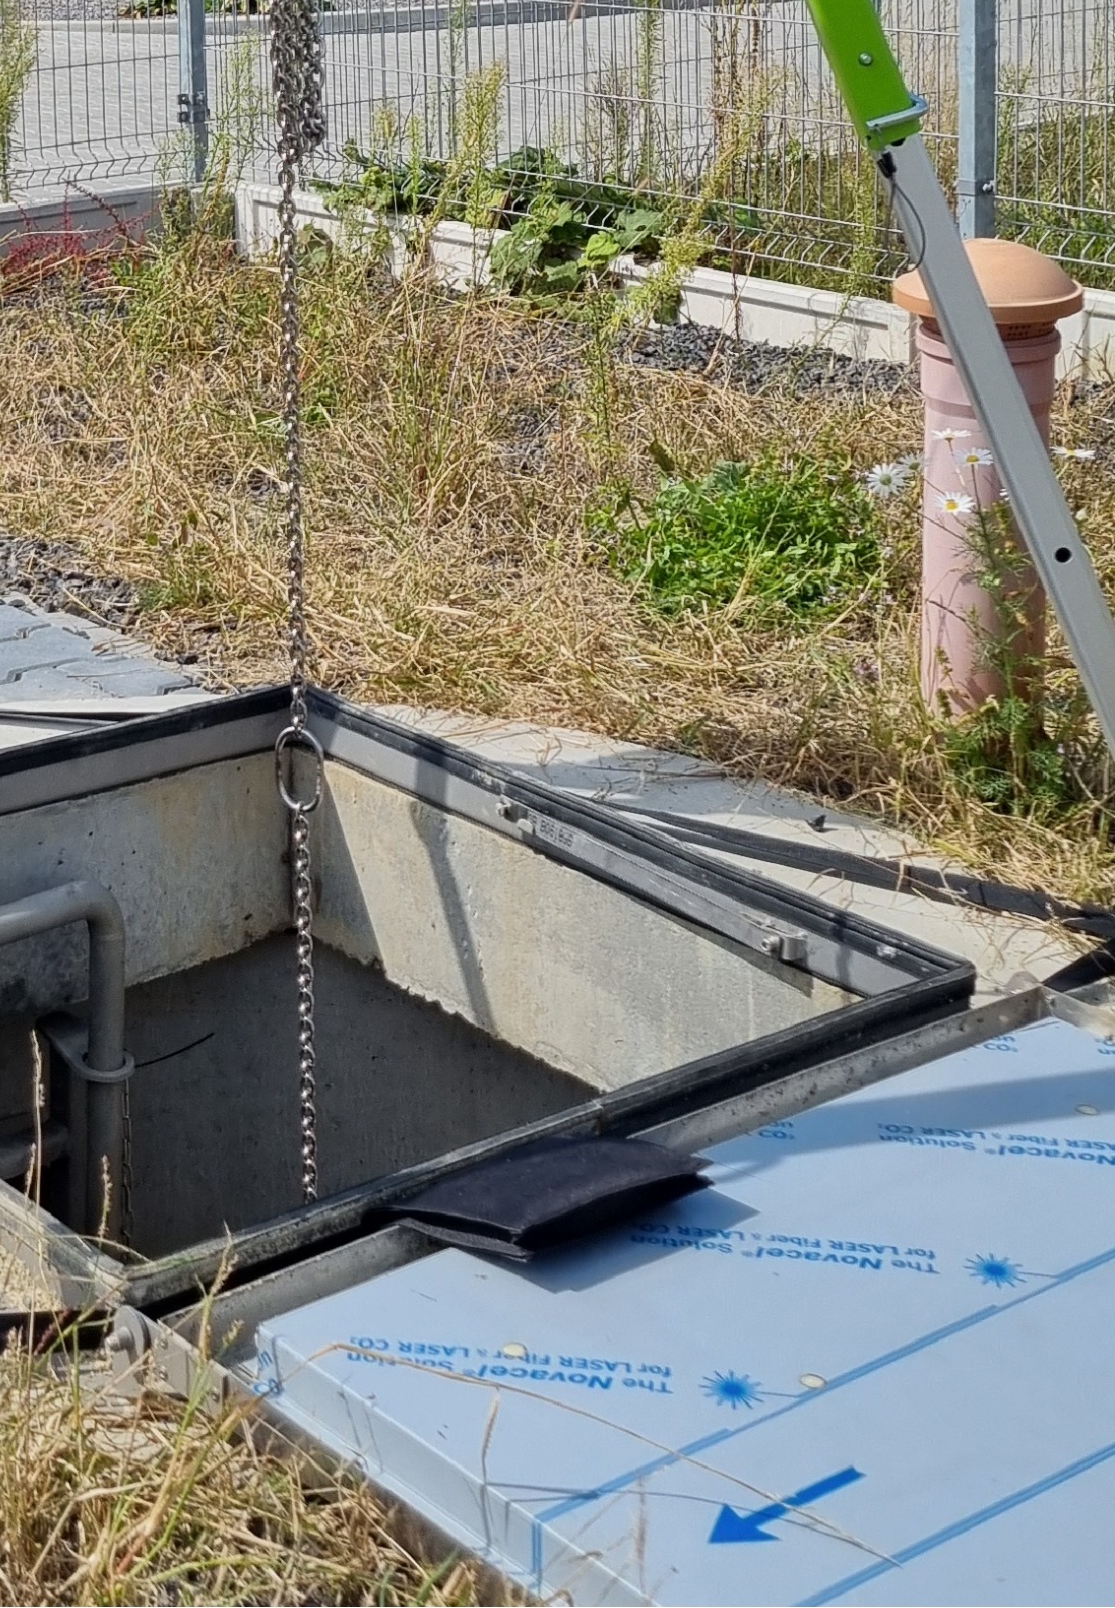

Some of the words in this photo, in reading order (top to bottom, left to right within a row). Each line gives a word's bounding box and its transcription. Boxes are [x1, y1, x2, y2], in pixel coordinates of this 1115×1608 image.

[921, 1127, 986, 1140] LASER
[1008, 1133, 1059, 1147] Fiber
[879, 1134, 976, 1152] Solution
[1065, 1138, 1115, 1152] ASER
[638, 1223, 670, 1235] CO
[677, 1225, 745, 1242] LASER
[631, 1234, 733, 1254] Solution
[766, 1234, 821, 1248] Fiber
[828, 1239, 900, 1256] LASER
[904, 1247, 936, 1260] for
[891, 1259, 941, 1275] The
[397, 1341, 470, 1359] LASER
[347, 1351, 455, 1372] Sotion
[559, 1354, 632, 1374] LASER
[637, 1362, 672, 1378] for
[623, 1377, 674, 1395] The
